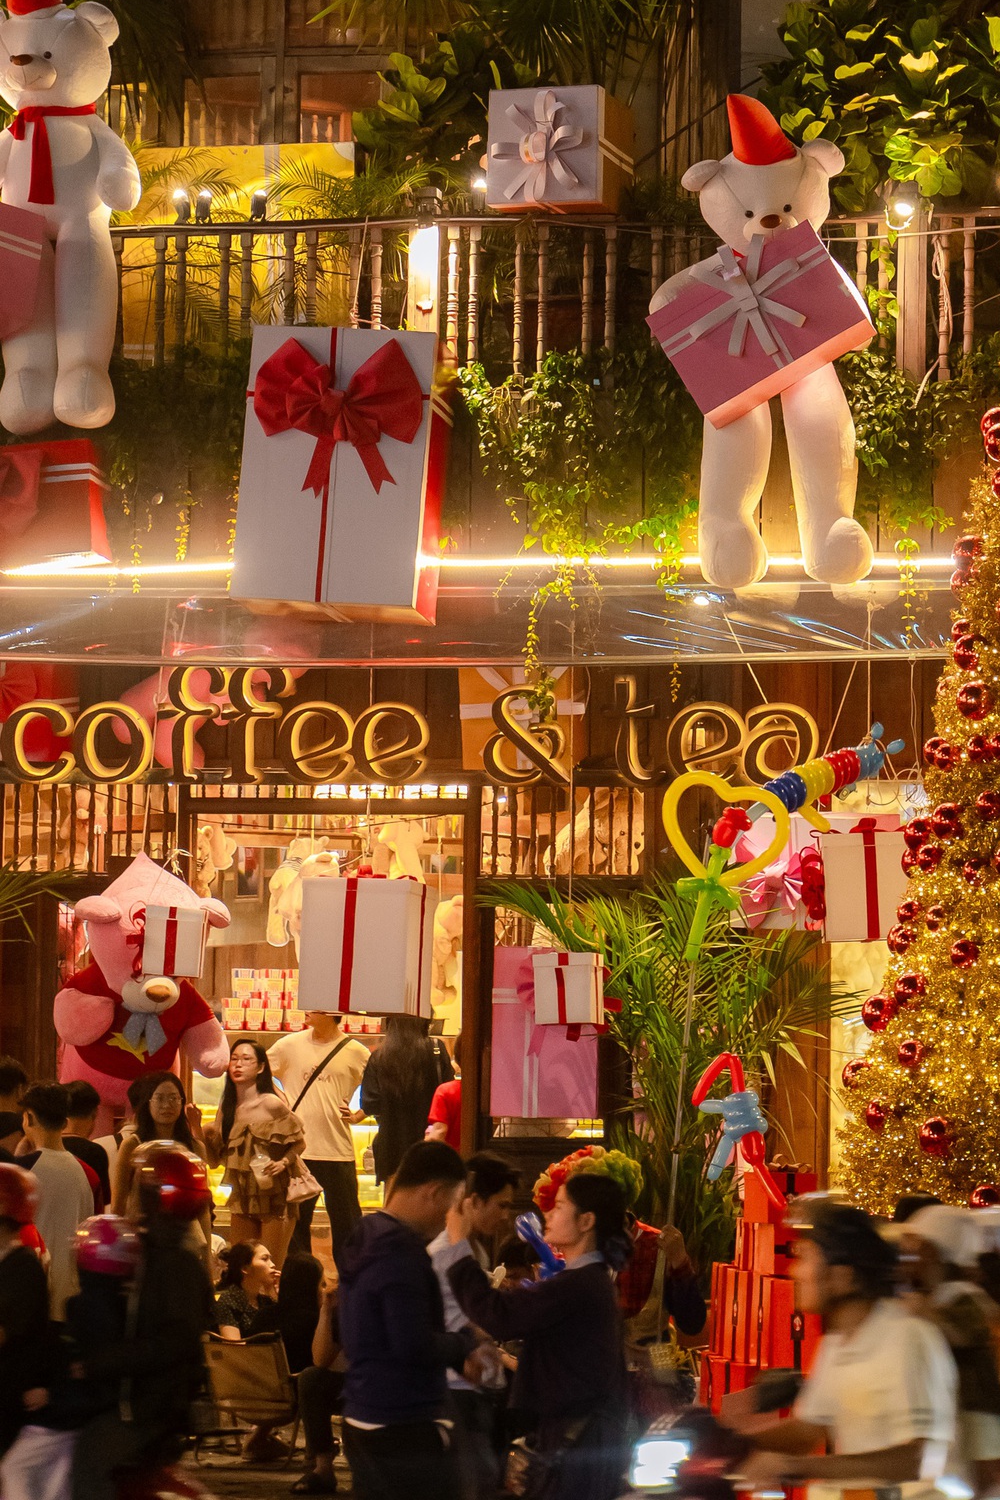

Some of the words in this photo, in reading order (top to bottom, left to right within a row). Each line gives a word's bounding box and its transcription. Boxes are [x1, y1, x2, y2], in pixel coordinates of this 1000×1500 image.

[2, 666, 429, 784] coffee
[482, 683, 572, 786] &
[613, 673, 819, 787] tea
